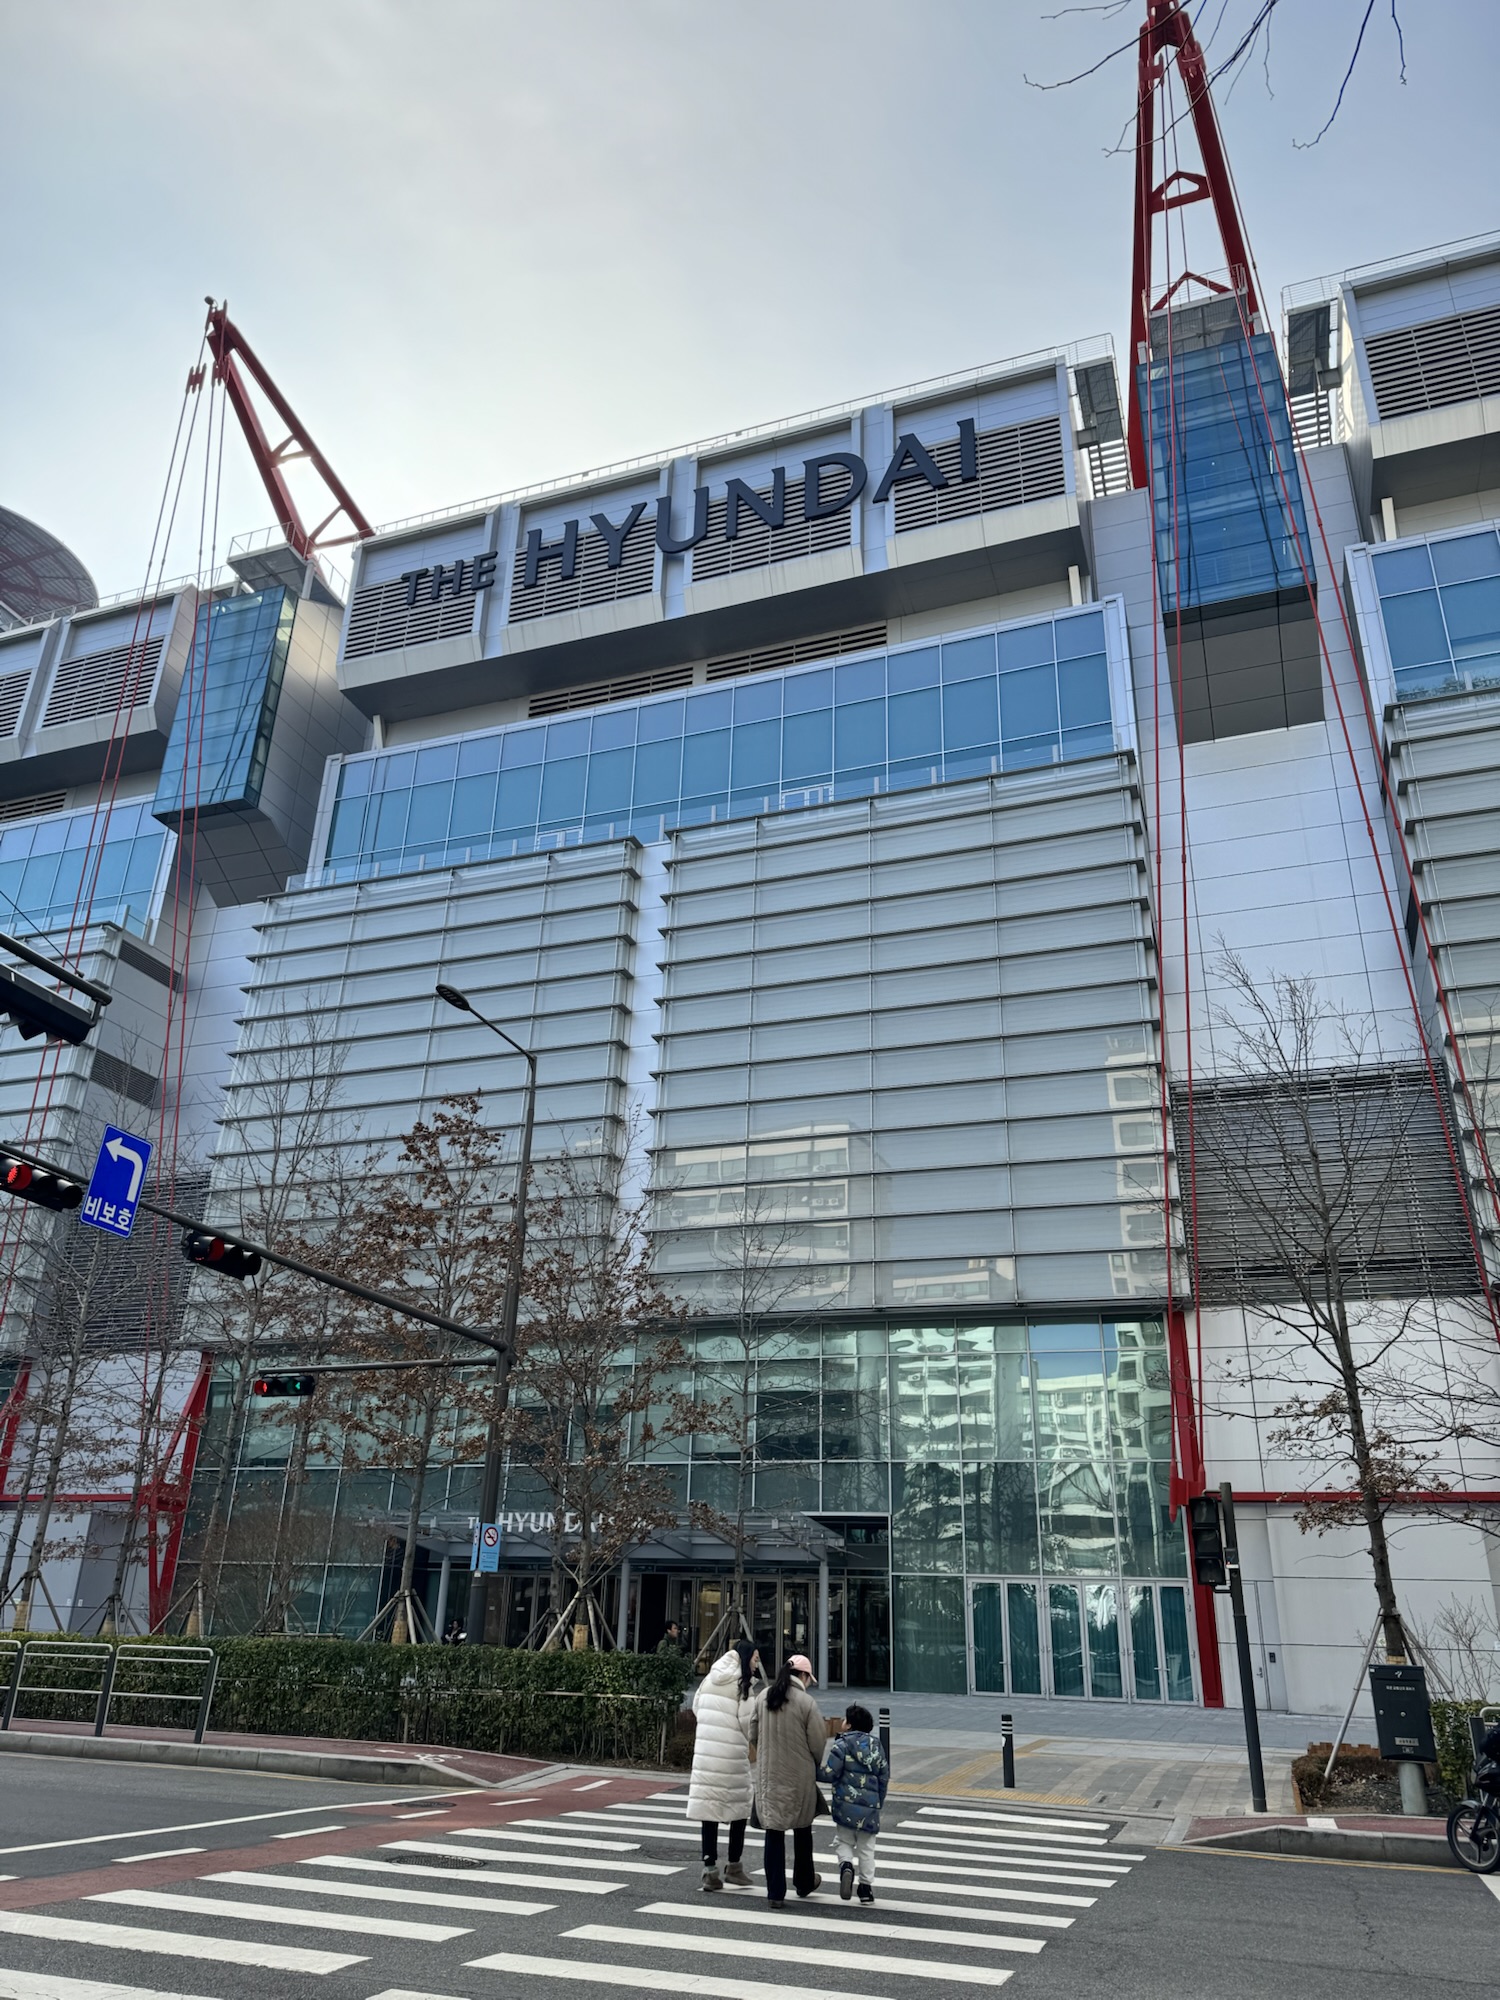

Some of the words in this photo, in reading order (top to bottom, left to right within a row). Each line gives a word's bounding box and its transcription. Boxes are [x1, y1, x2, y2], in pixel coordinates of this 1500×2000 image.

[402, 551, 498, 606] THE
[524, 418, 976, 588] HYUNDAI
[84, 1196, 132, 1231] 비보호
